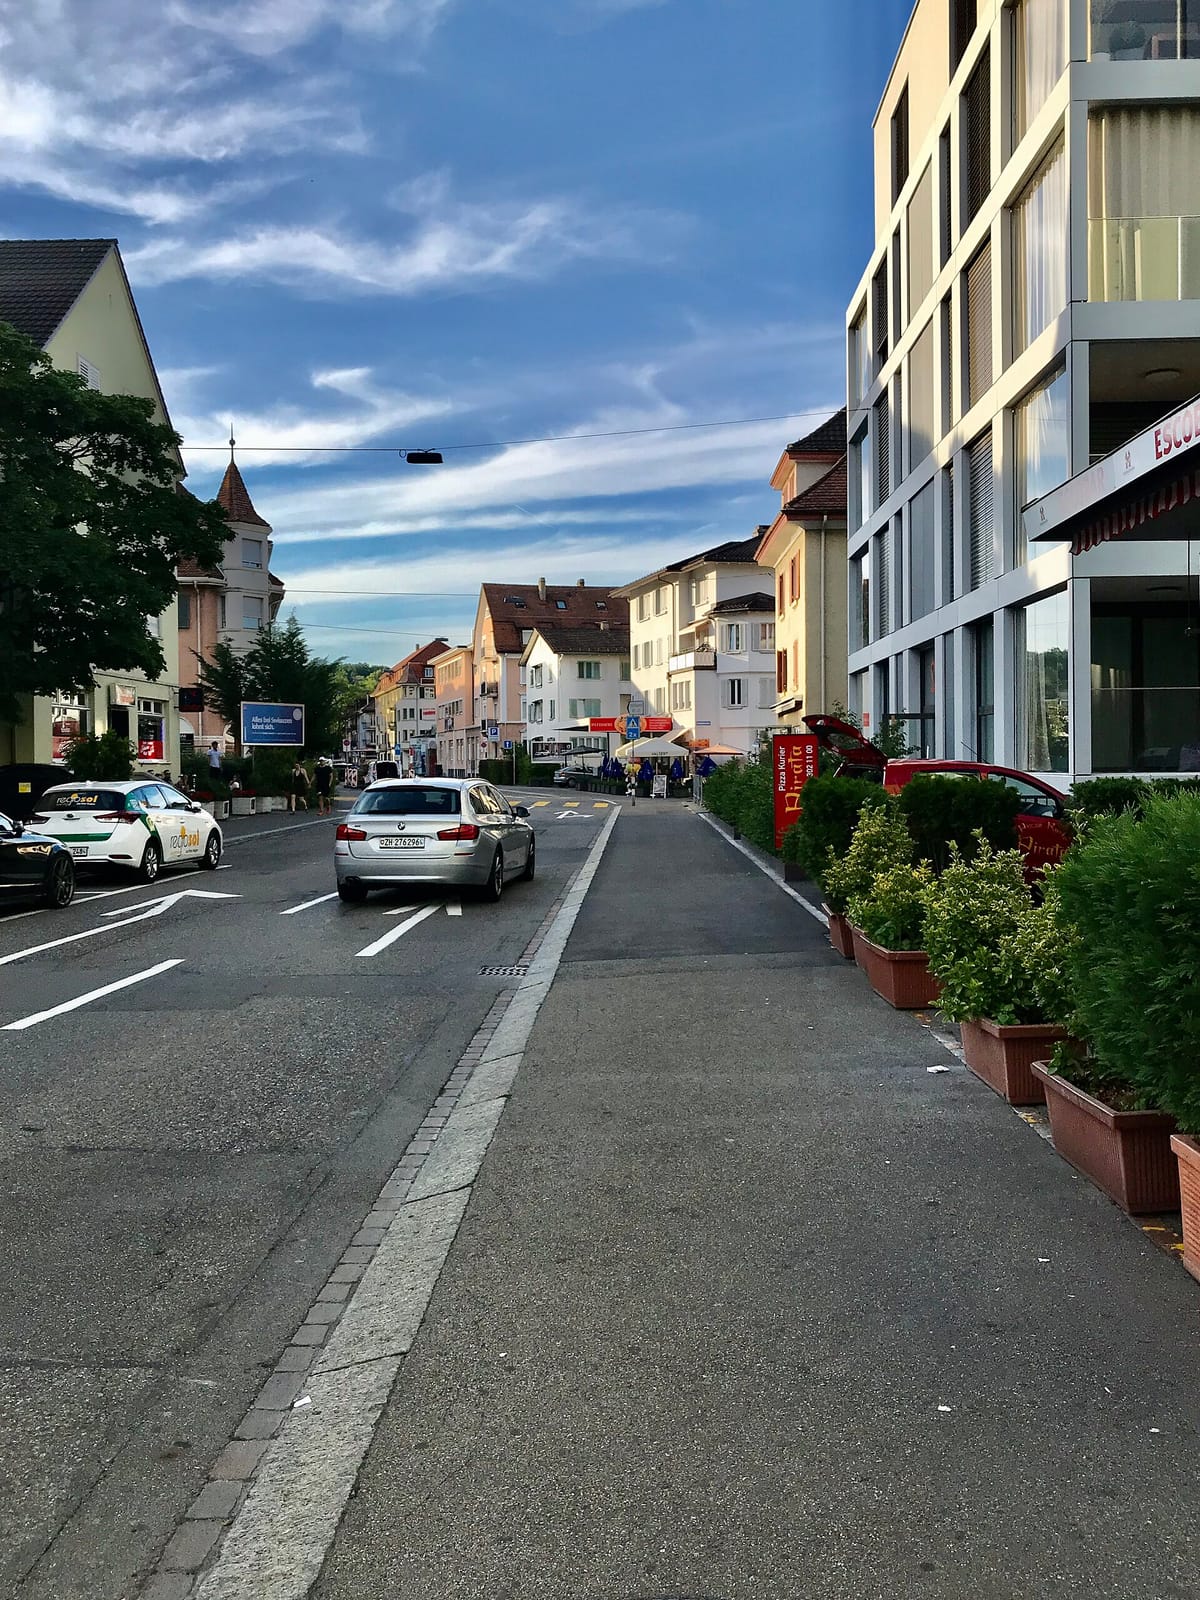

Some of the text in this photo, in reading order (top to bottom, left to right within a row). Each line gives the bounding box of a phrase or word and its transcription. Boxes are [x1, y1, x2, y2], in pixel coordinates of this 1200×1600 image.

[778, 746, 786, 792] Pizza Kurier
[785, 745, 804, 814] Pirata
[384, 838, 420, 846] ZH 276296
